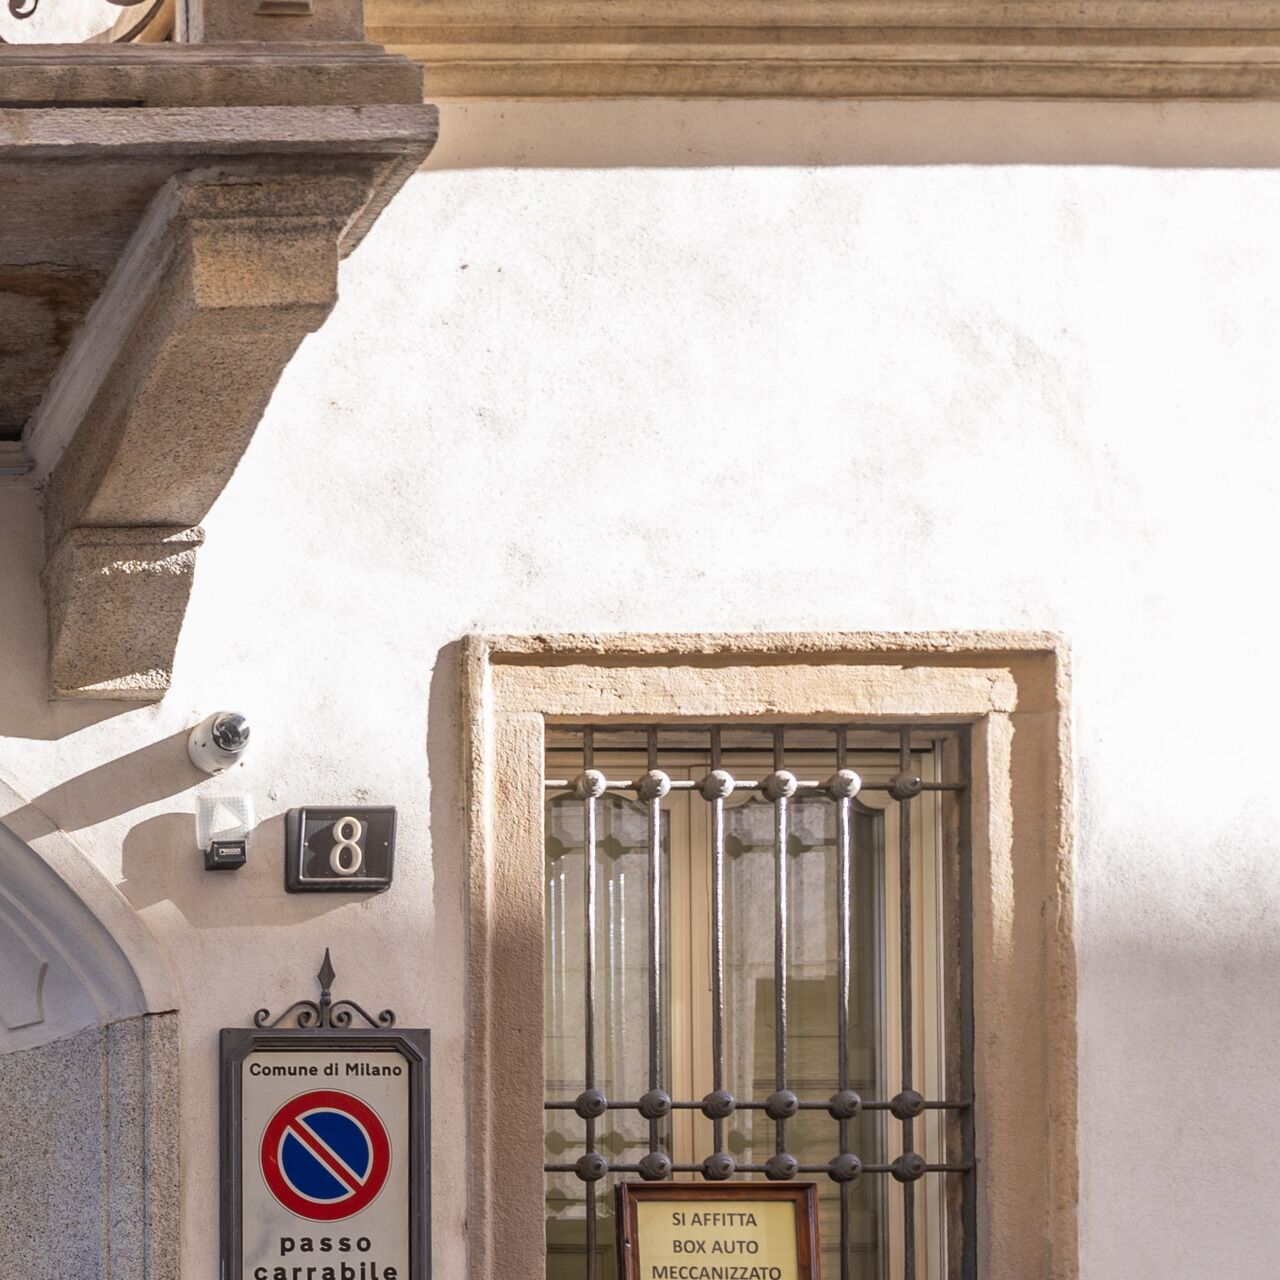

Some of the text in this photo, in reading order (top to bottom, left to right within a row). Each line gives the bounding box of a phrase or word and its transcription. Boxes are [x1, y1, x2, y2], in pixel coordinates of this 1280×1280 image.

[329, 816, 362, 876] 8
[249, 1062, 402, 1077] Comune di Milano
[672, 1212, 757, 1227] SI AFFITTA
[280, 1236, 372, 1256] passo
[673, 1239, 759, 1254] BOX AUTO
[652, 1265, 782, 1280] MECCANIZZATO
